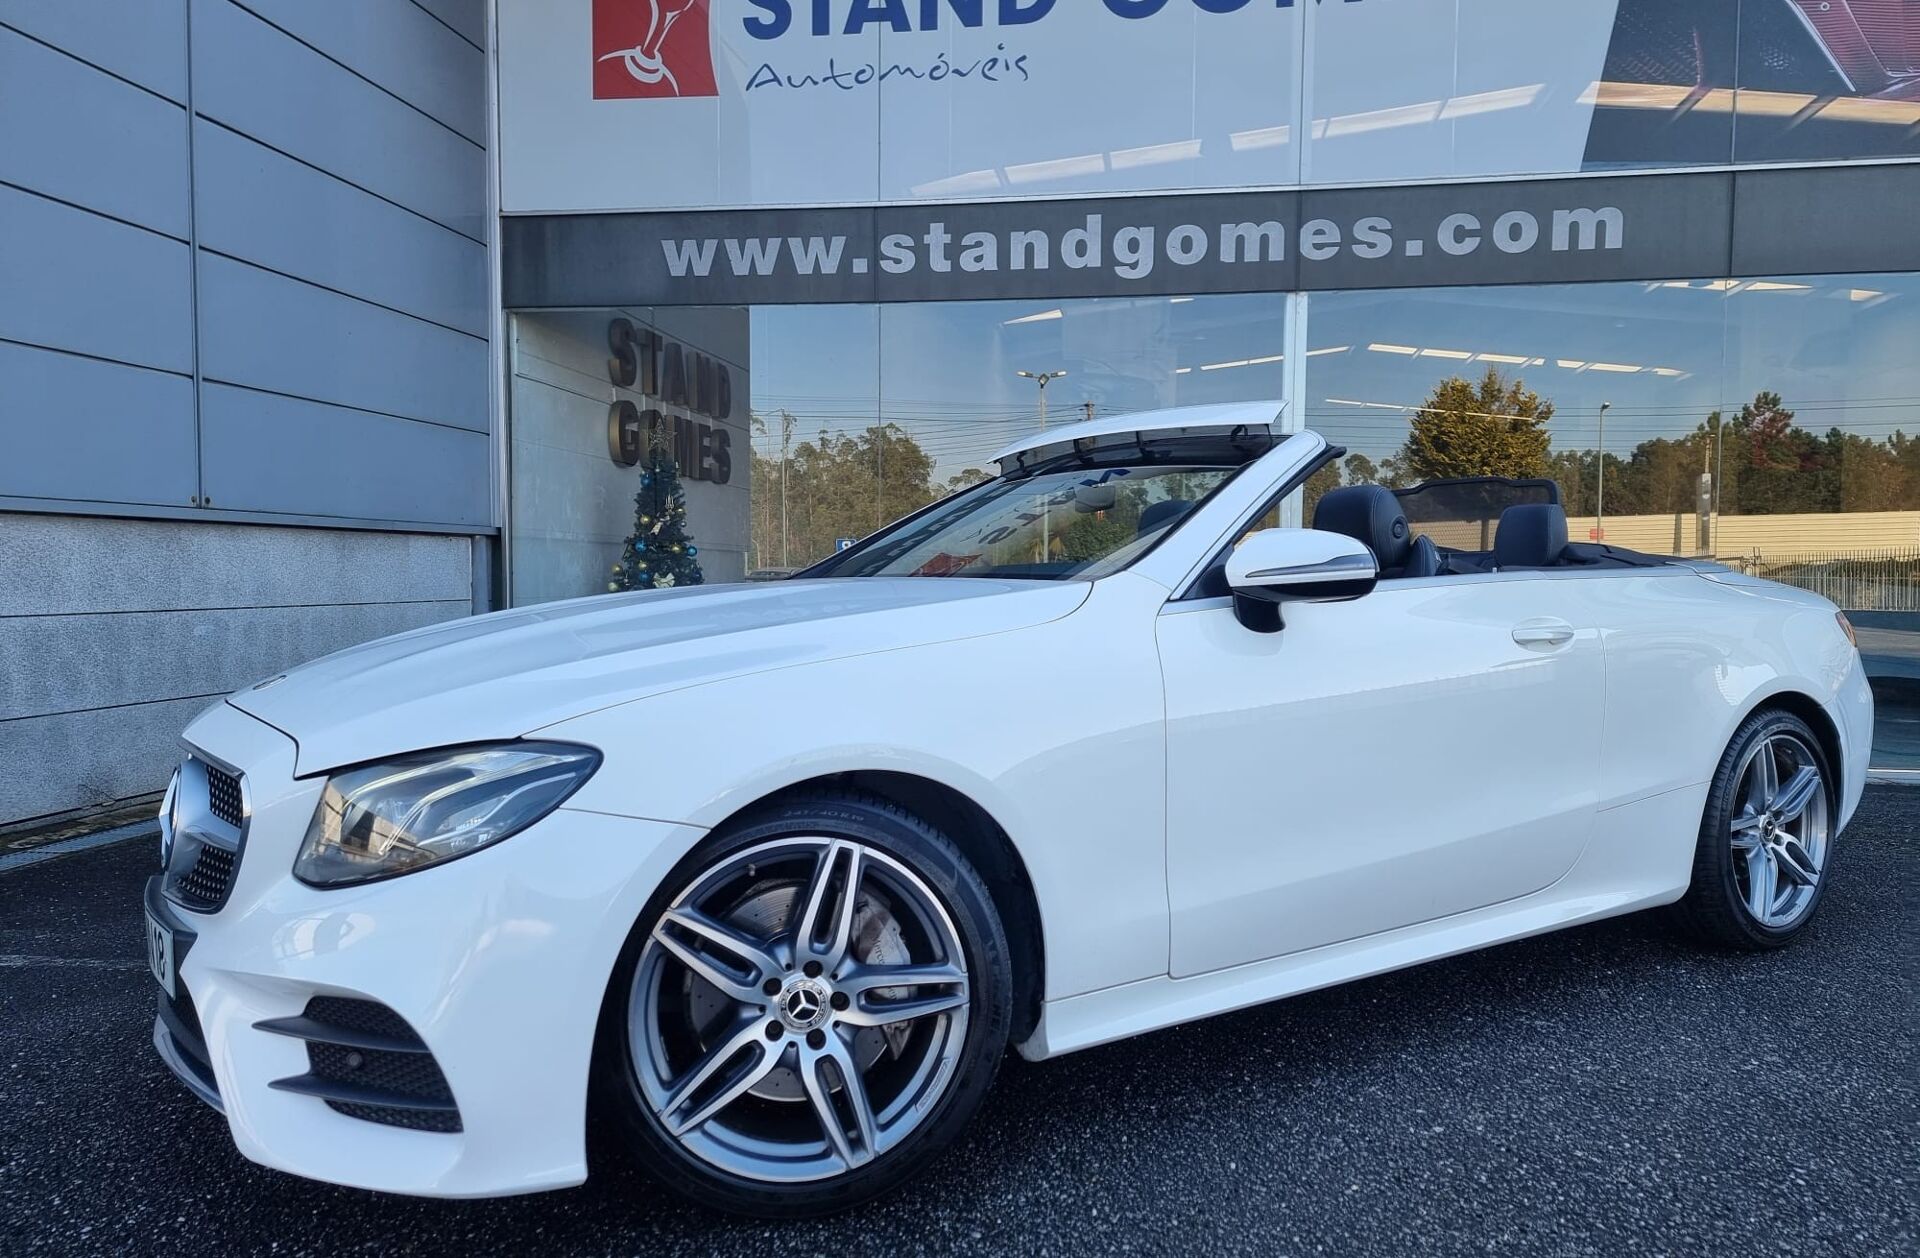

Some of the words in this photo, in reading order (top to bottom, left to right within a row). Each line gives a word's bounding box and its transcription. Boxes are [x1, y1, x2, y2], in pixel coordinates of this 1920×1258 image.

[746, 43, 1028, 91] Automóveis
[660, 205, 1625, 280] www.standgomes.com
[608, 318, 731, 419] STAND
